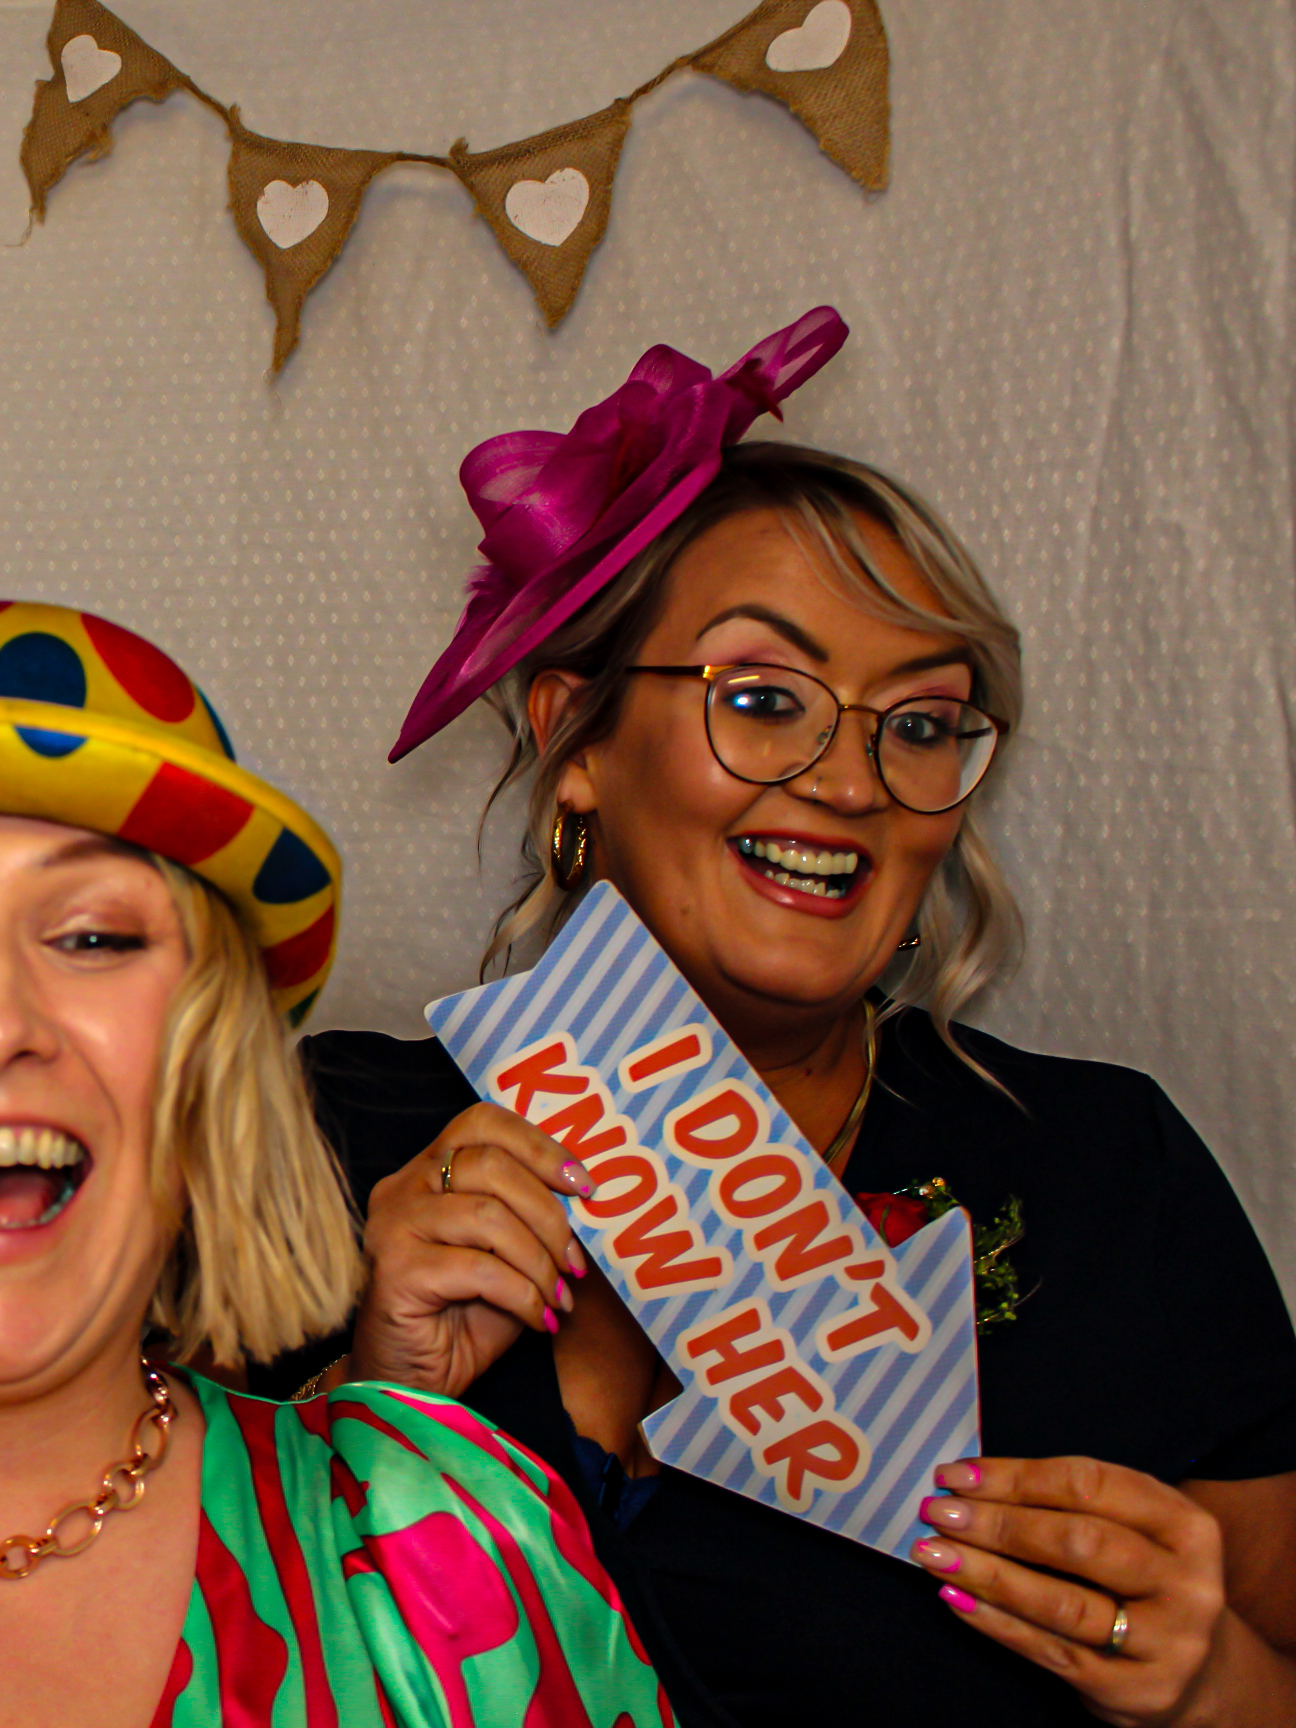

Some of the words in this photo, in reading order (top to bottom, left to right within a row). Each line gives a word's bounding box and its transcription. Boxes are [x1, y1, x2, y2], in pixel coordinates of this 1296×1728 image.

[496, 1041, 723, 1290] KNOW
[686, 1307, 860, 1502] HER
[628, 1033, 702, 1083] I
[673, 1088, 920, 1353] DON'T
